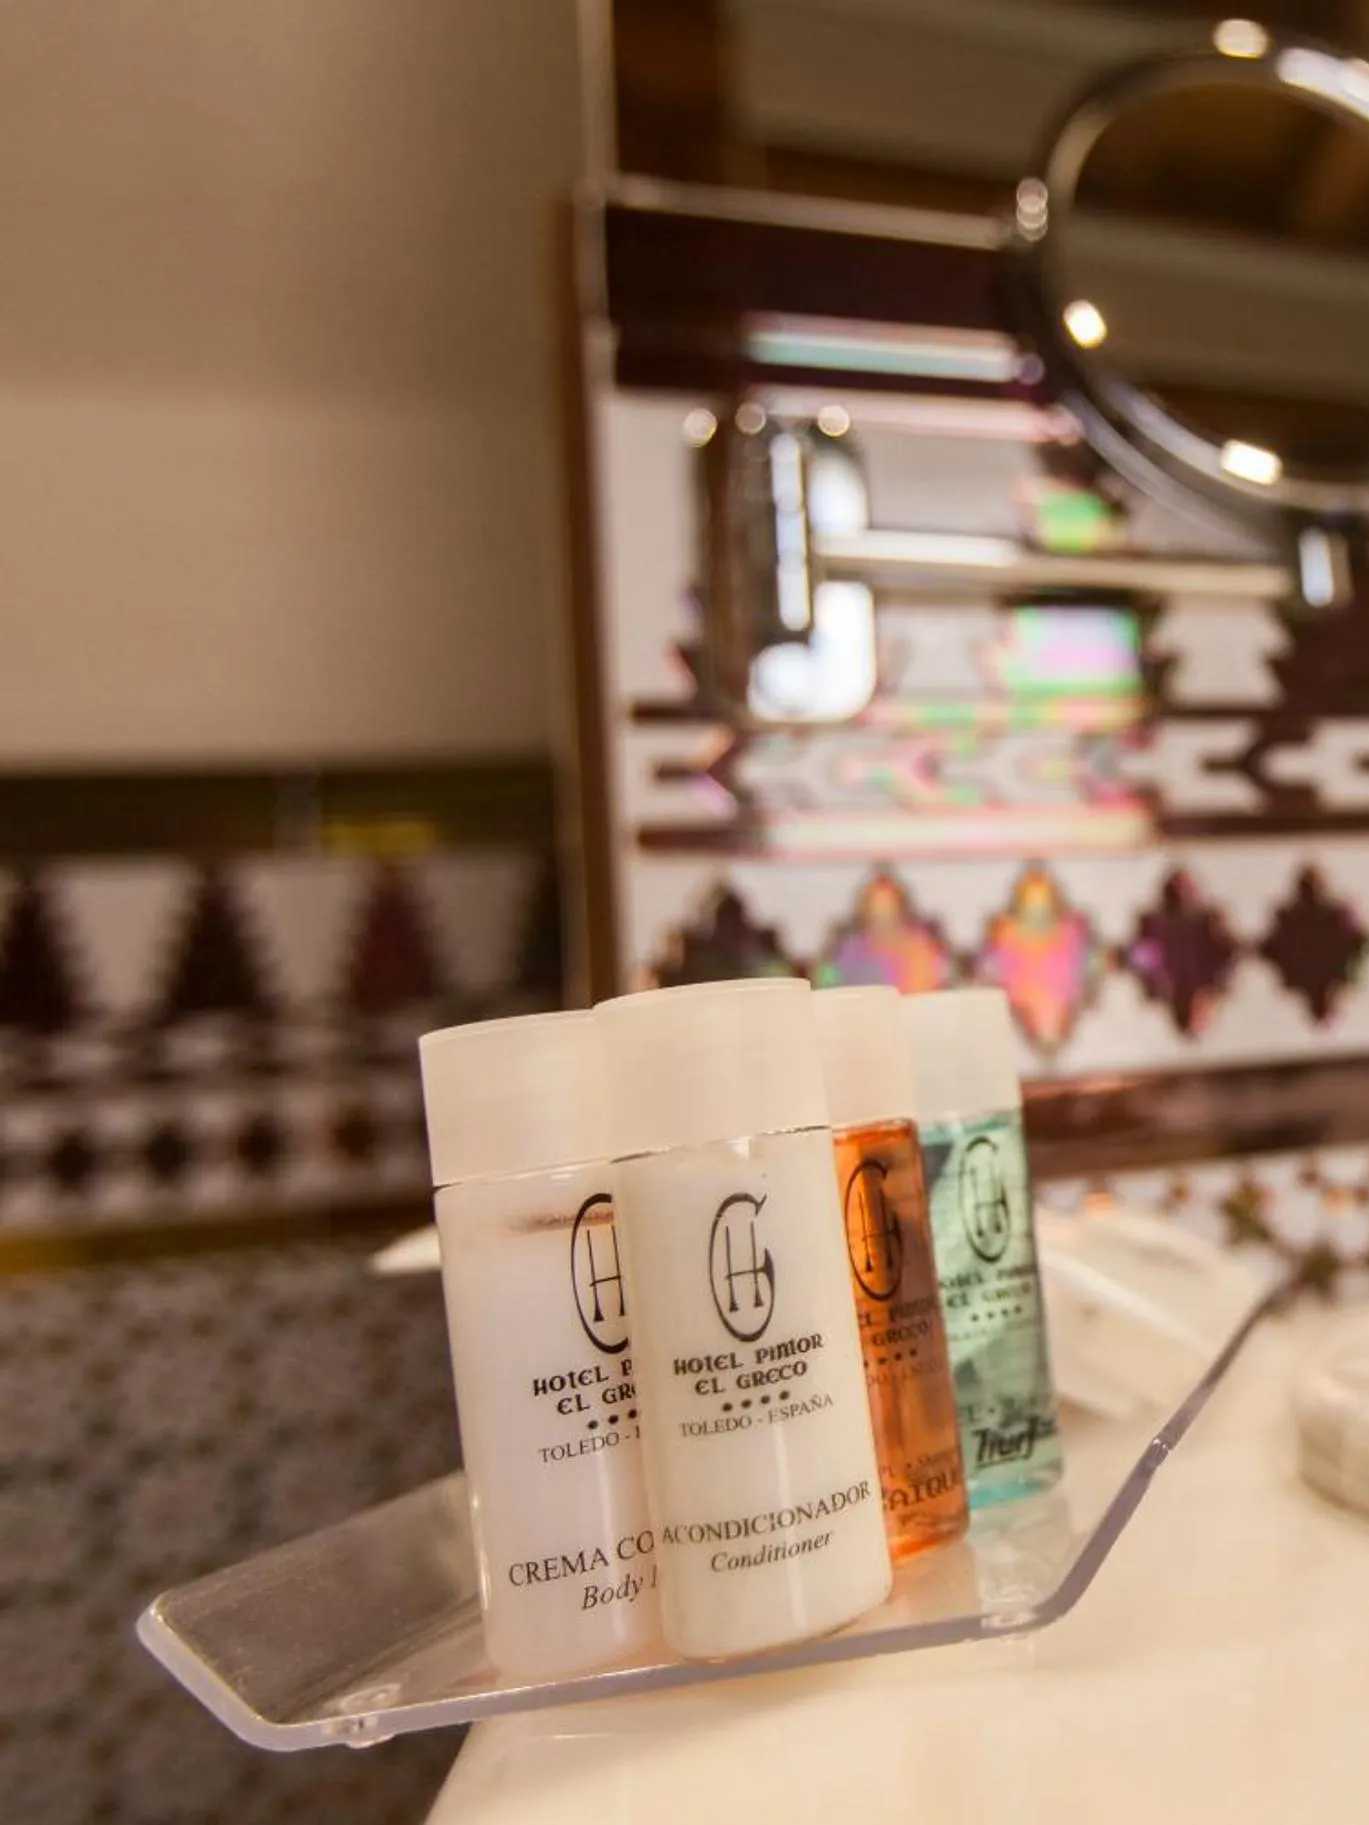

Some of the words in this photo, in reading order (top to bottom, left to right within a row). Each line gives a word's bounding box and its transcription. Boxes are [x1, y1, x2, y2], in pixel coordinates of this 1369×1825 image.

[673, 1352, 744, 1376] HOTEL
[755, 1333, 824, 1365] PINTOR
[533, 1366, 609, 1396] HOTEL
[694, 1377, 726, 1395] EL
[736, 1360, 808, 1390] GRECO
[557, 1394, 590, 1415] EL
[679, 1415, 752, 1438] TOLEDO
[767, 1393, 834, 1425] ESPAÑA
[539, 1432, 620, 1463] TOLEDO
[661, 1479, 871, 1545] ACONDICIONADOR
[508, 1547, 609, 1587] CREMA
[710, 1529, 834, 1573] Conditioner
[581, 1573, 644, 1610] Body
